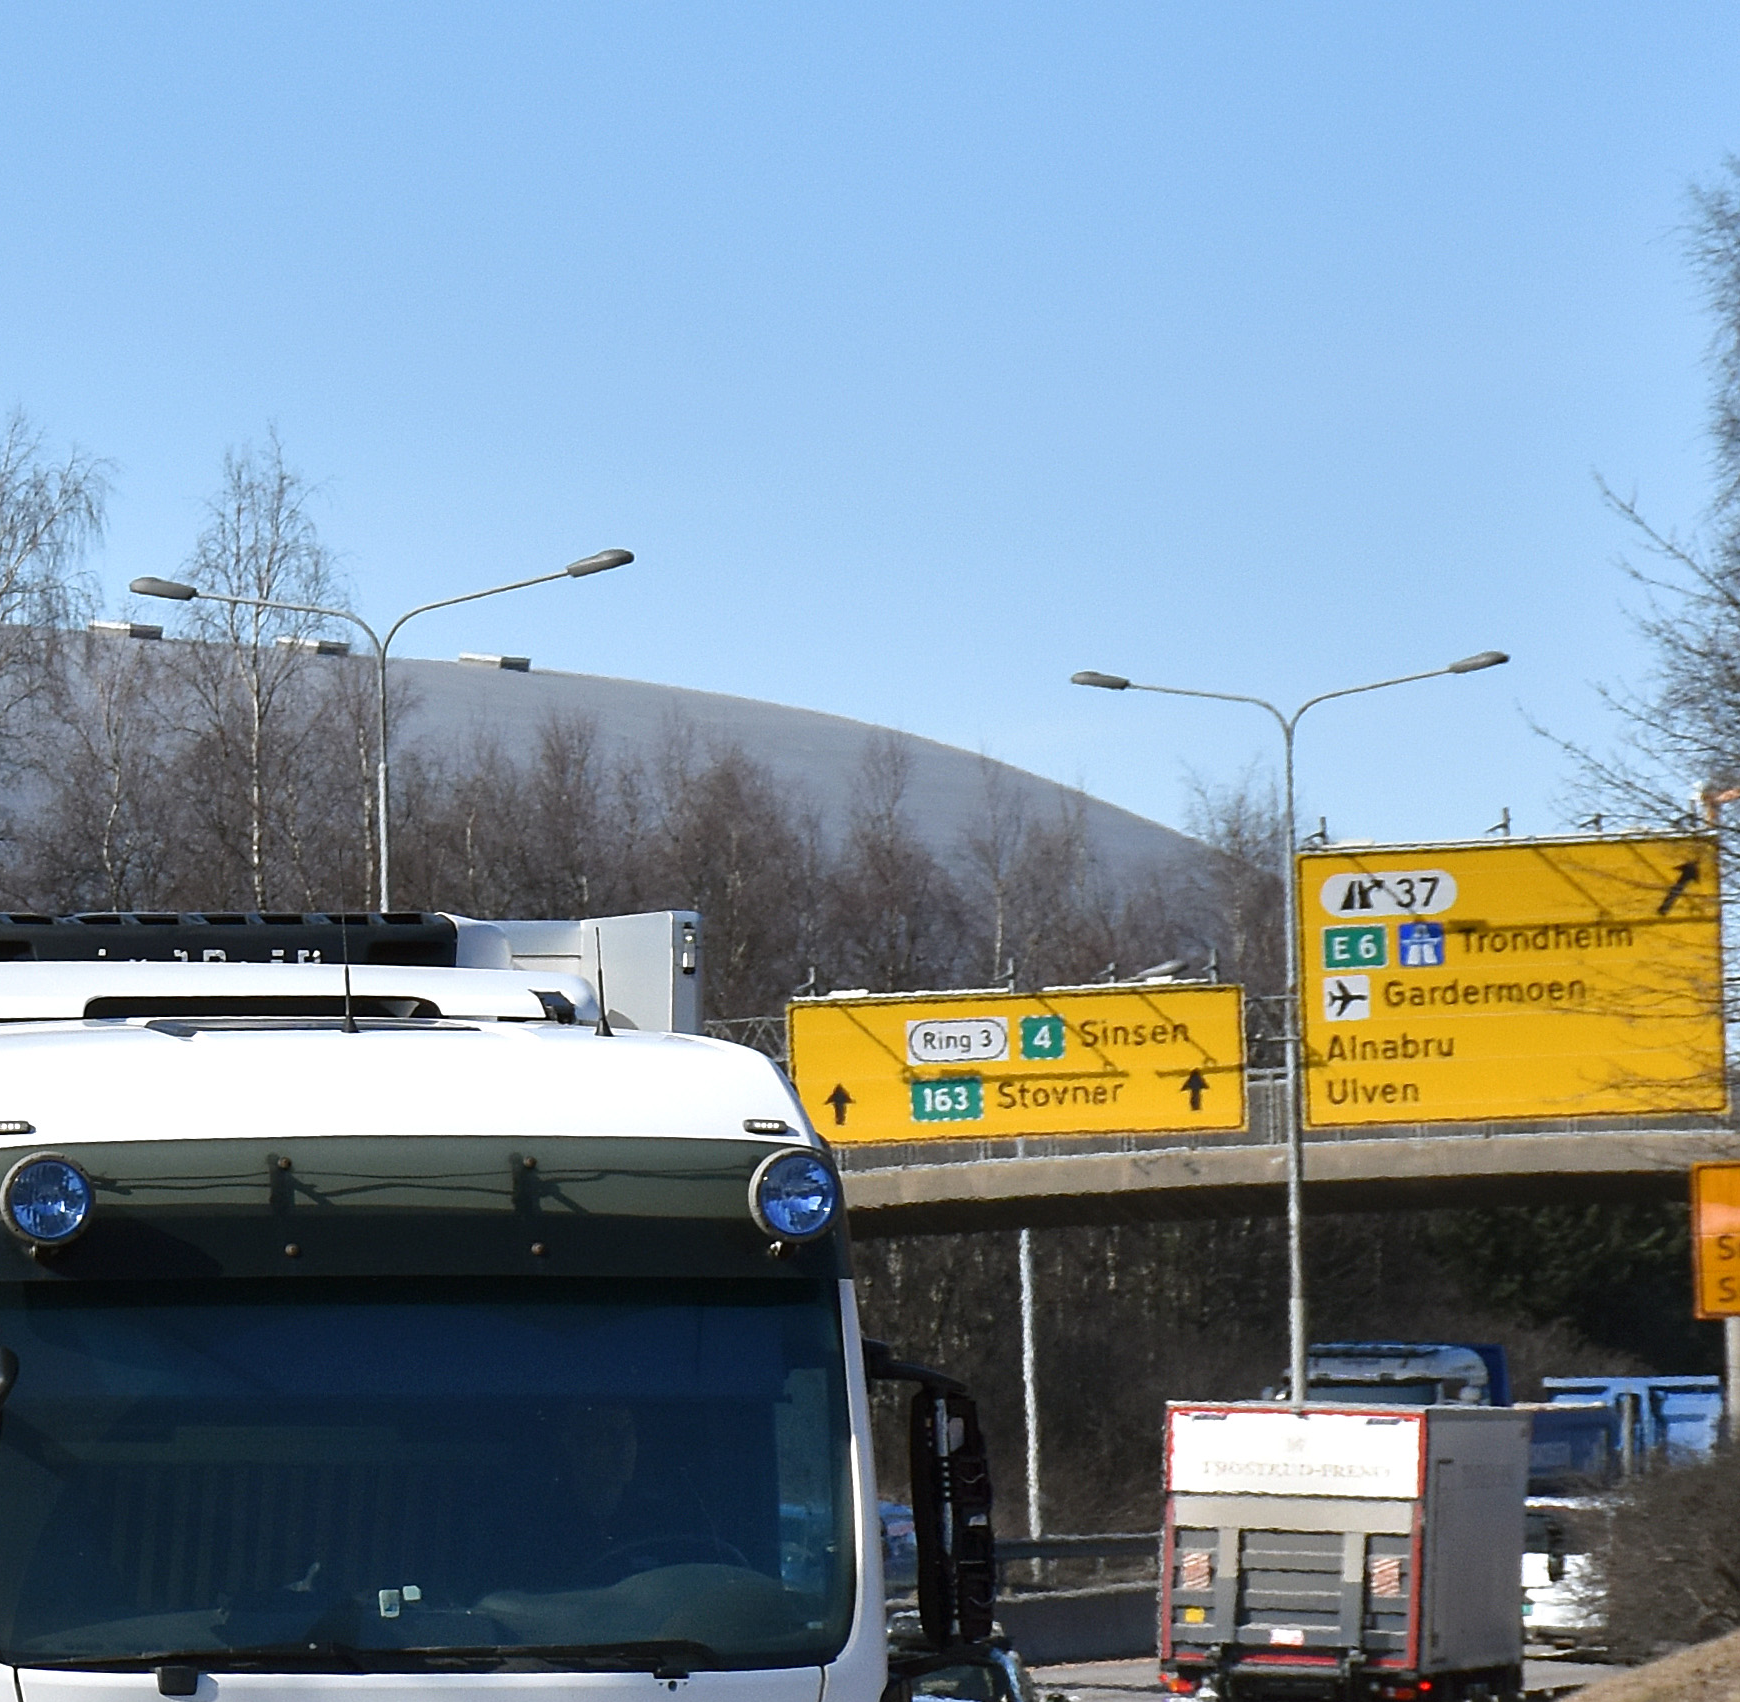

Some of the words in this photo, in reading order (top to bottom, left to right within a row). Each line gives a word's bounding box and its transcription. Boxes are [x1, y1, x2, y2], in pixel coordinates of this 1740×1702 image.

[1396, 876, 1440, 908] 37
[1458, 926, 1633, 955] Trondheim
[1384, 978, 1586, 1007] Gardermoen
[923, 1031, 972, 1053] Ring
[979, 1030, 993, 1048] 3
[1033, 1028, 1052, 1049] 4
[1081, 1020, 1190, 1048] Sinsen
[1328, 1032, 1455, 1063] Alnabru
[923, 1088, 969, 1112] 163
[997, 1081, 1125, 1109] Stovner
[1327, 1078, 1419, 1106] Ulven
